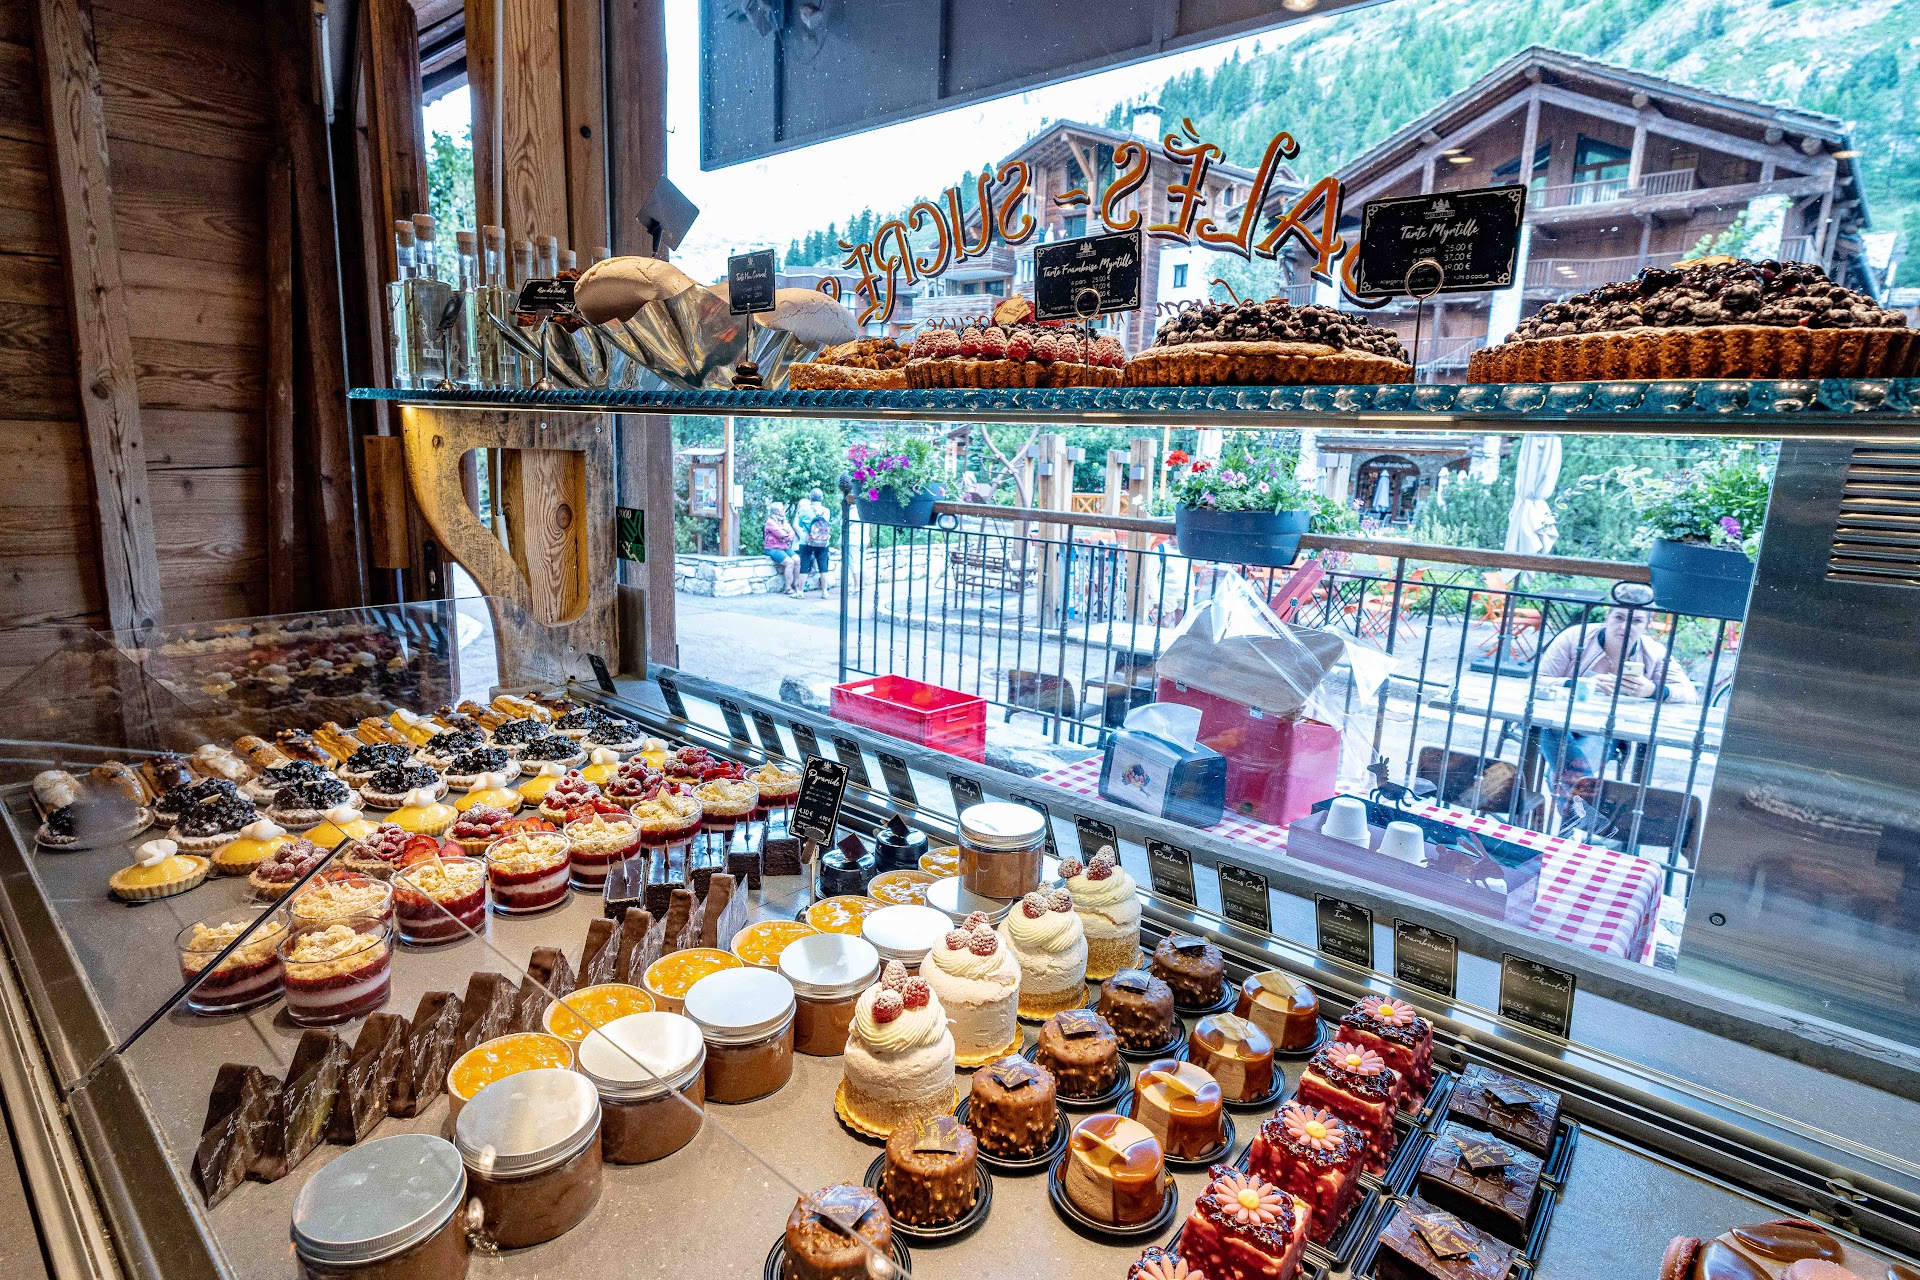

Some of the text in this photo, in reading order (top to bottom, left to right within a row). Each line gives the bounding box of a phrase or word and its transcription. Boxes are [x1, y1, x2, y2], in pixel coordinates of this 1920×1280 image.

[1400, 217, 1479, 244] Tarte Myrtille
[1042, 265, 1061, 278] Tarte
[1061, 261, 1099, 276] Framboise
[1099, 252, 1134, 275] Myrtille
[808, 768, 840, 788] Pyramide
